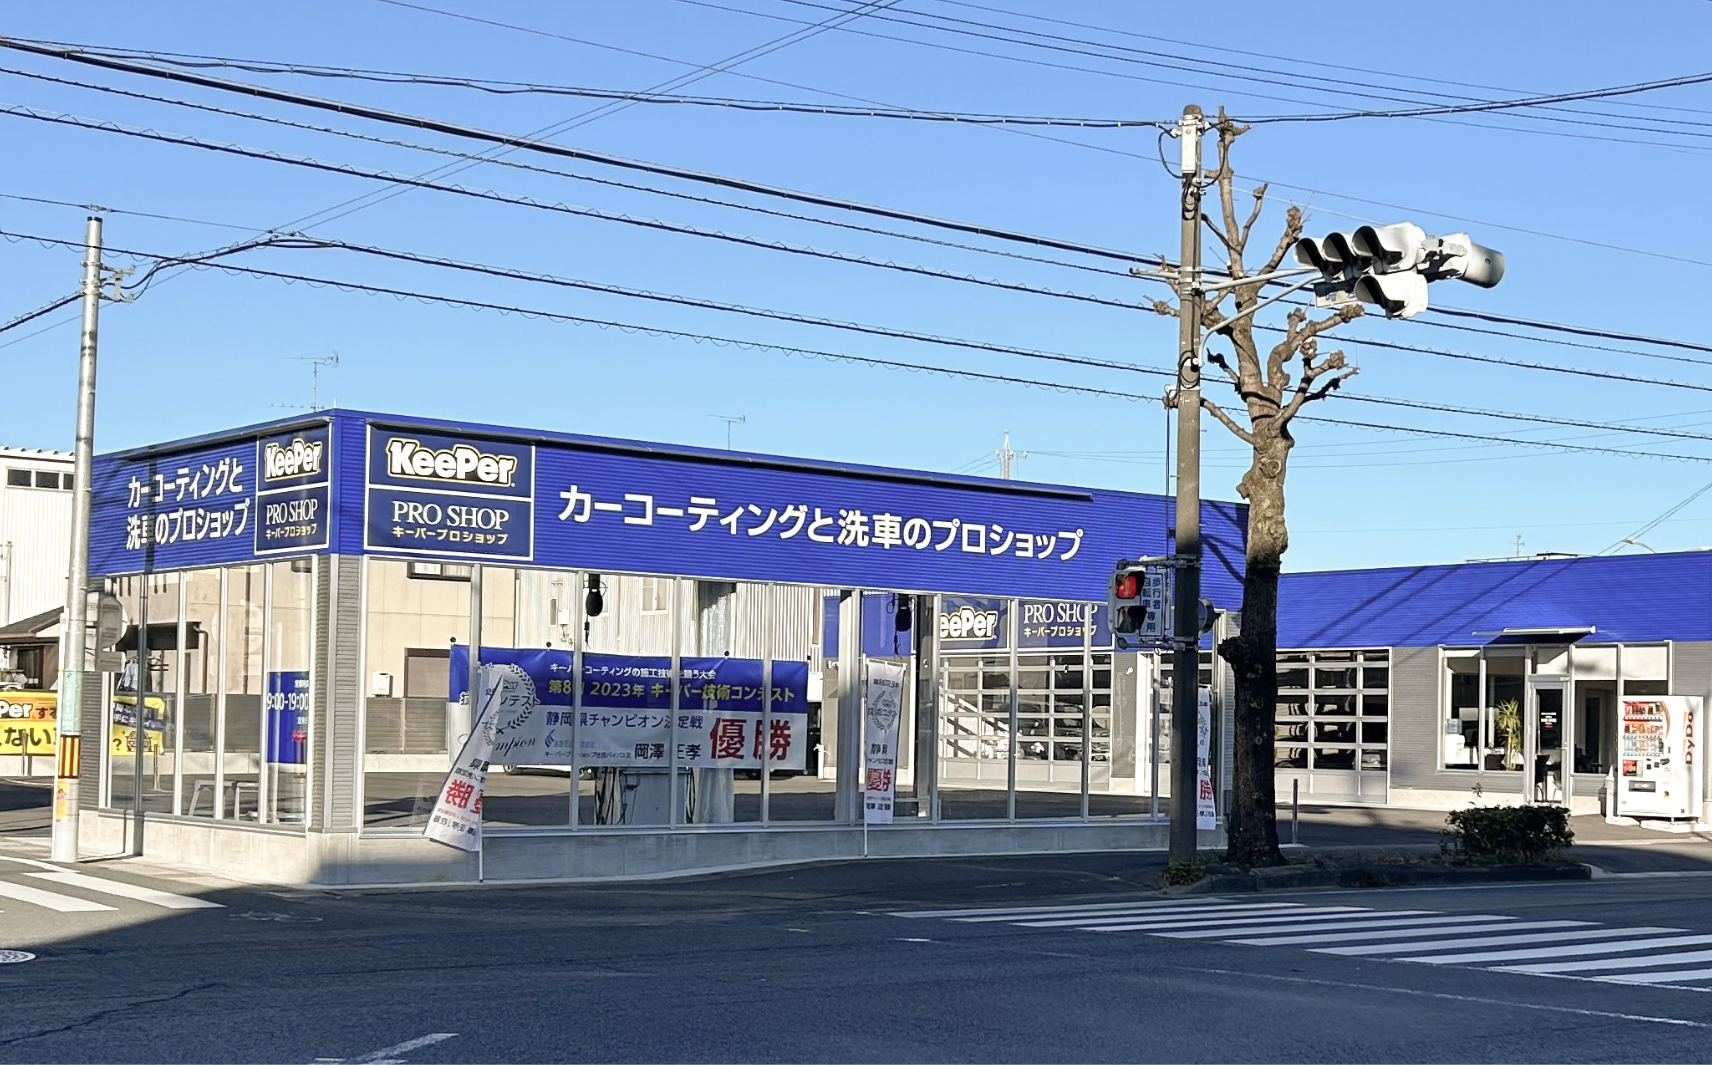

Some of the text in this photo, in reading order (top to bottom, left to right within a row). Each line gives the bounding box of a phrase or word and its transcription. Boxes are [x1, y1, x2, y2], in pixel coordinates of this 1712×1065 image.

[265, 439, 322, 482] KeePer
[387, 438, 517, 487] KeePer
[127, 457, 243, 509] カーコーティングと
[126, 498, 250, 550] 洗車のプロショップ
[265, 499, 318, 525] PRO SHOP
[391, 500, 510, 531] PRO SHOP
[558, 484, 1085, 561] カーコーティングと洗車のプロショップ
[265, 523, 317, 541] キーパープロショップ
[391, 525, 509, 545] キーパープロショップ
[1023, 603, 1054, 624] PRO
[1023, 624, 1097, 638] キーパープロショプ
[589, 681, 646, 698] 2023年
[709, 717, 792, 761] 優勝
